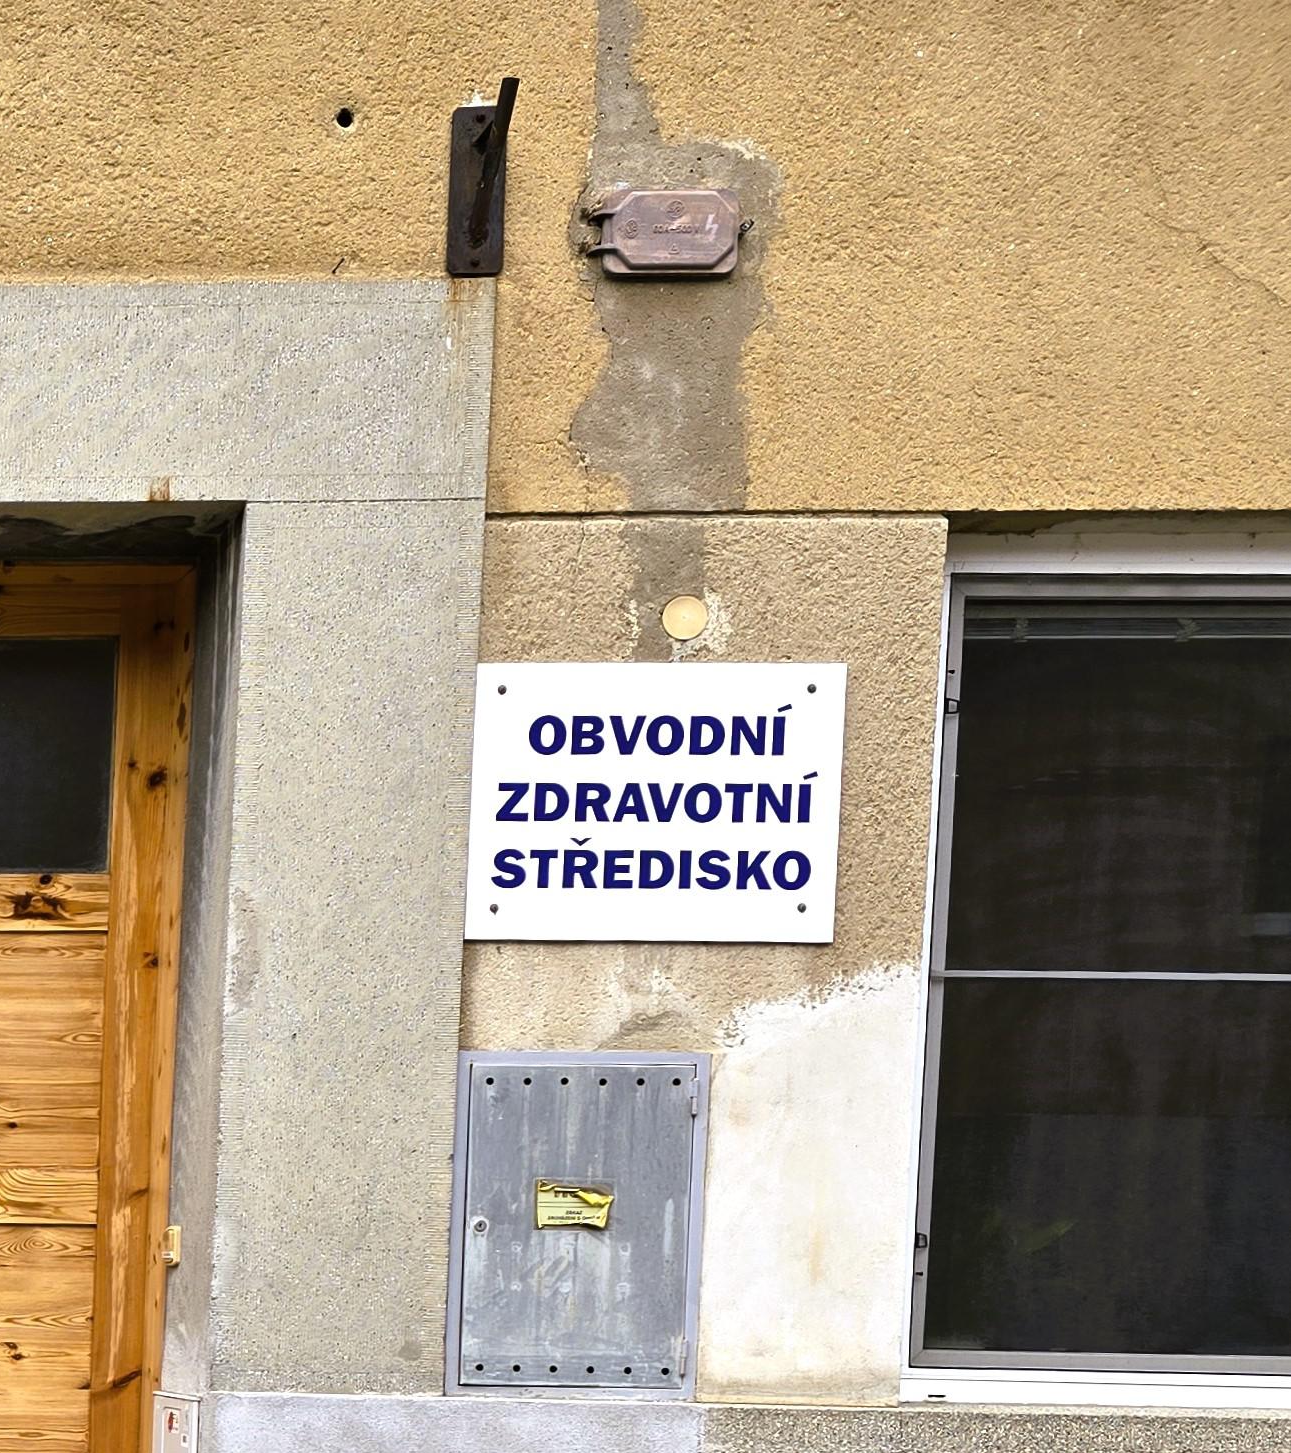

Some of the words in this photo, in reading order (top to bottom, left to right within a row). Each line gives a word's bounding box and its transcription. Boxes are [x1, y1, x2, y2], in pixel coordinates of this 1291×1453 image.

[528, 703, 792, 756] OBVODNÍ
[495, 771, 818, 823] ZDRAVOTNÍ
[490, 837, 812, 890] STŘEDISKO
